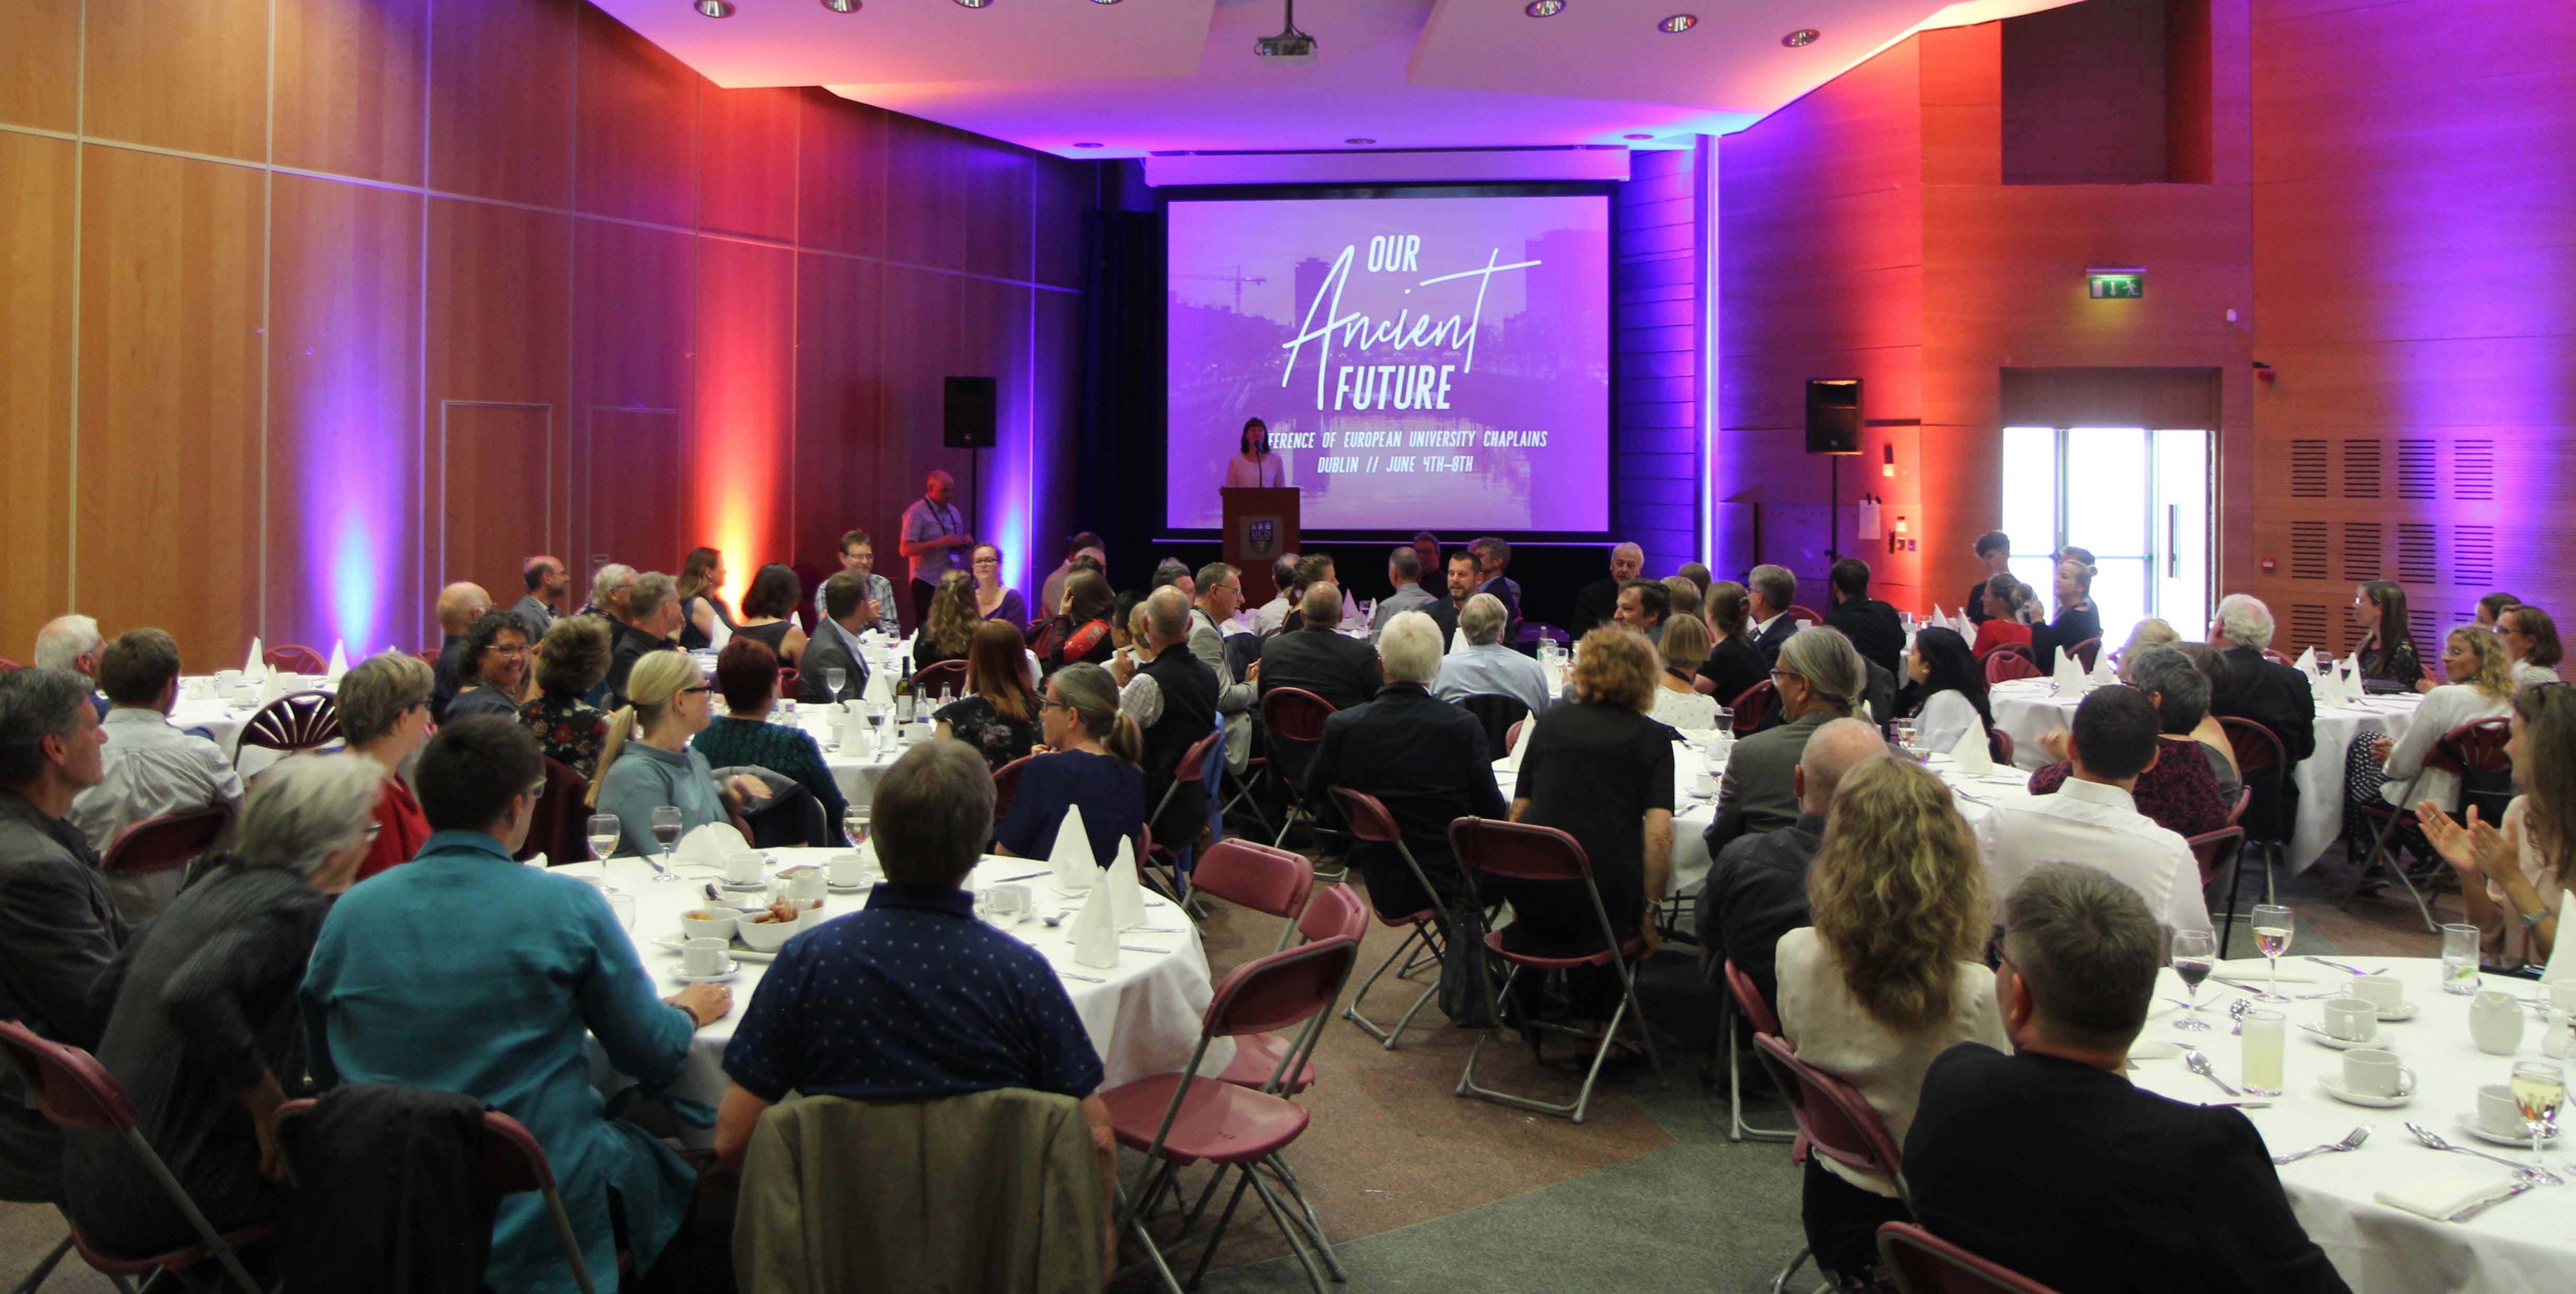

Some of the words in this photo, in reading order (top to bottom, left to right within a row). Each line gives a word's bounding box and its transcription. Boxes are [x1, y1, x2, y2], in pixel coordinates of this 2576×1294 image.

[1367, 235, 1421, 272] OUR
[1282, 245, 1542, 411] Ancient
[1334, 365, 1456, 411] FUTURE
[1268, 432, 1316, 449] FERENCE
[1322, 432, 1337, 448] OF
[1343, 431, 1403, 448] EUROPEAN
[1408, 430, 1477, 447] UNIVERSITY
[1483, 430, 1548, 447] CHAPLAINS
[1317, 456, 1359, 473] DUBLIN
[1385, 456, 1416, 473] JUNE
